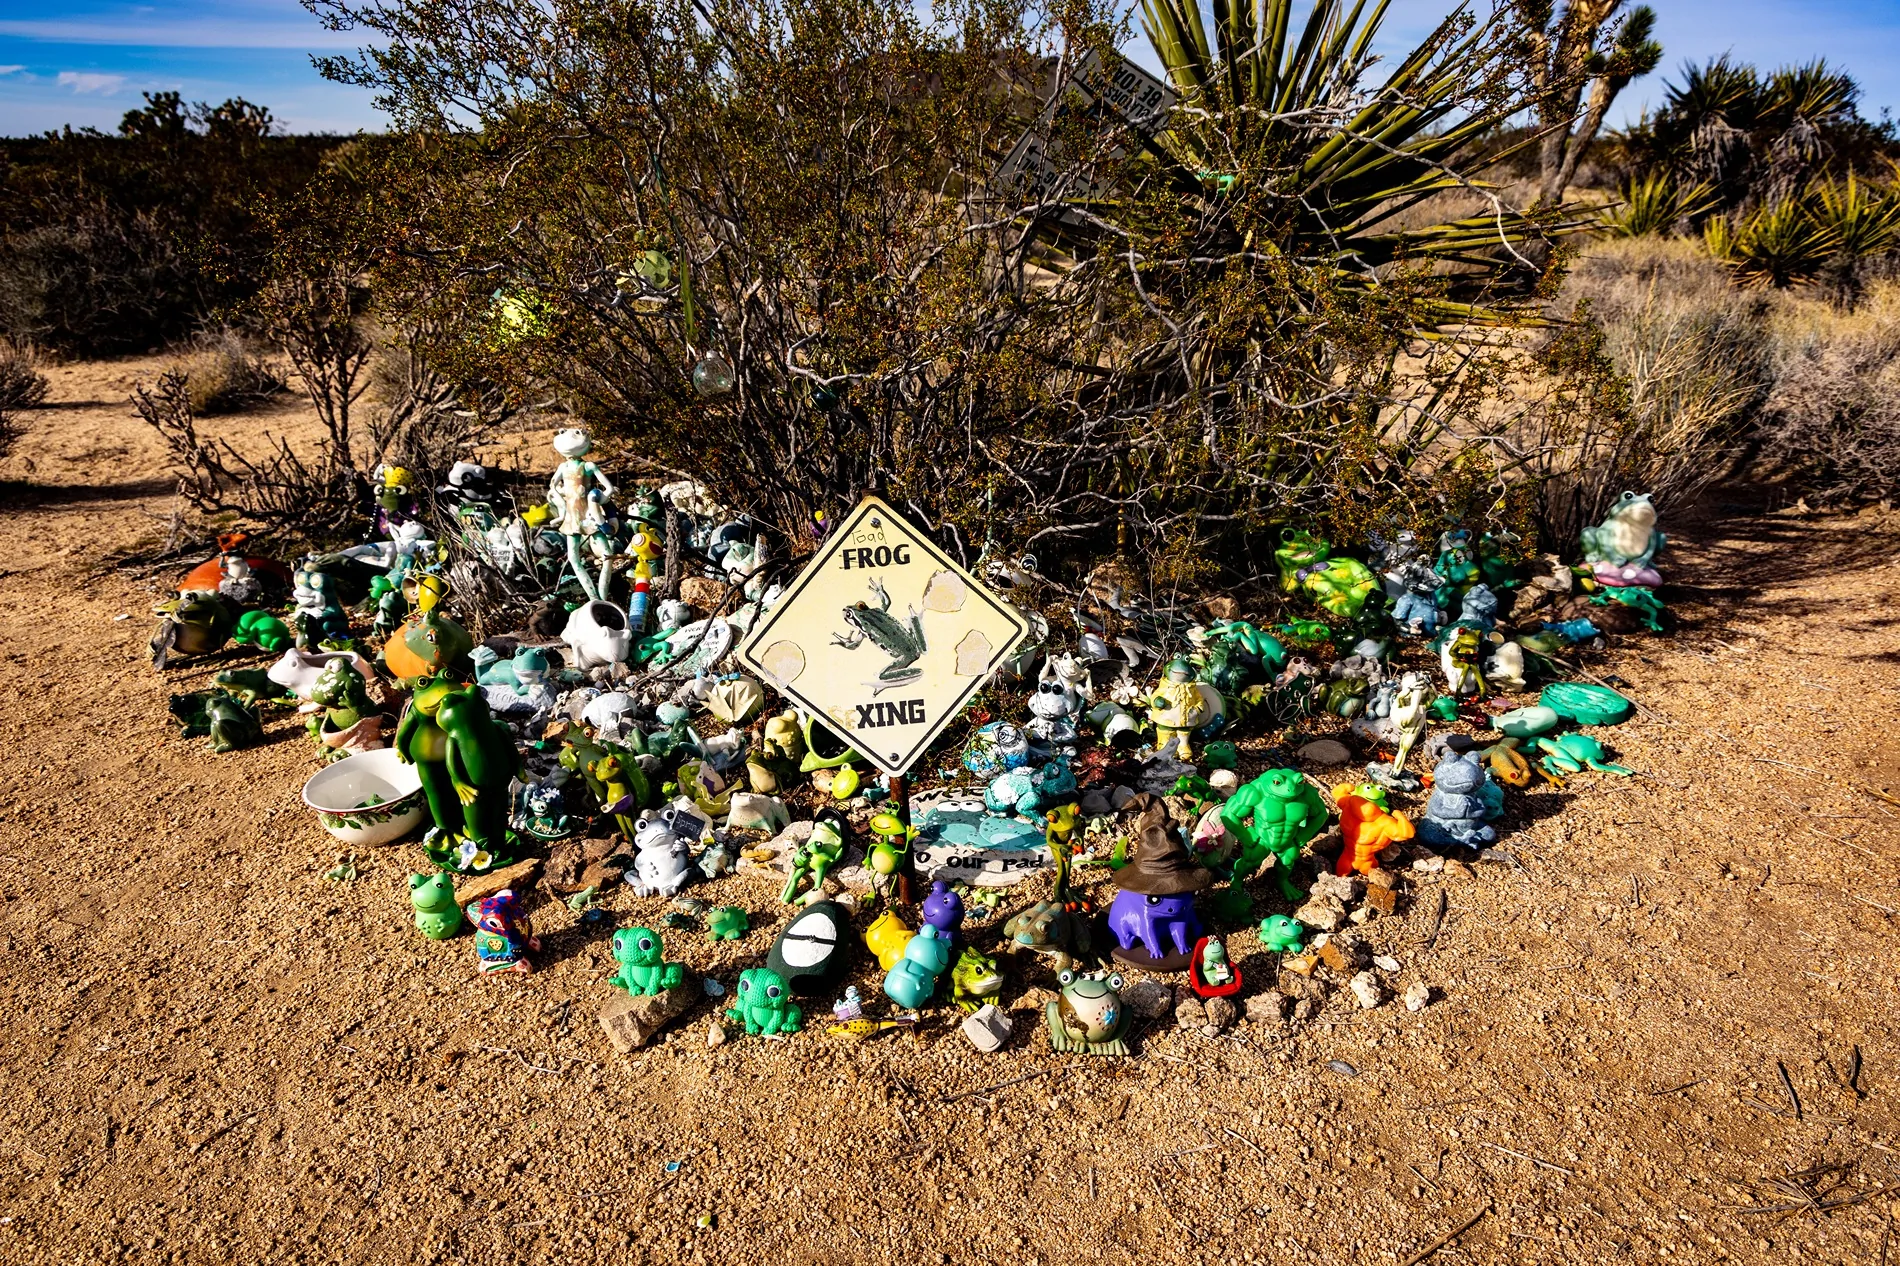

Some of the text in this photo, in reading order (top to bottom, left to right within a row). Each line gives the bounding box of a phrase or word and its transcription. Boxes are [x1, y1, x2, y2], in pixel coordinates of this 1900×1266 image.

[1111, 65, 1163, 109] BE TOA
[852, 525, 887, 545] Toad
[842, 543, 911, 570] FROG
[856, 699, 926, 729] XING
[913, 849, 1045, 872] o our pad
